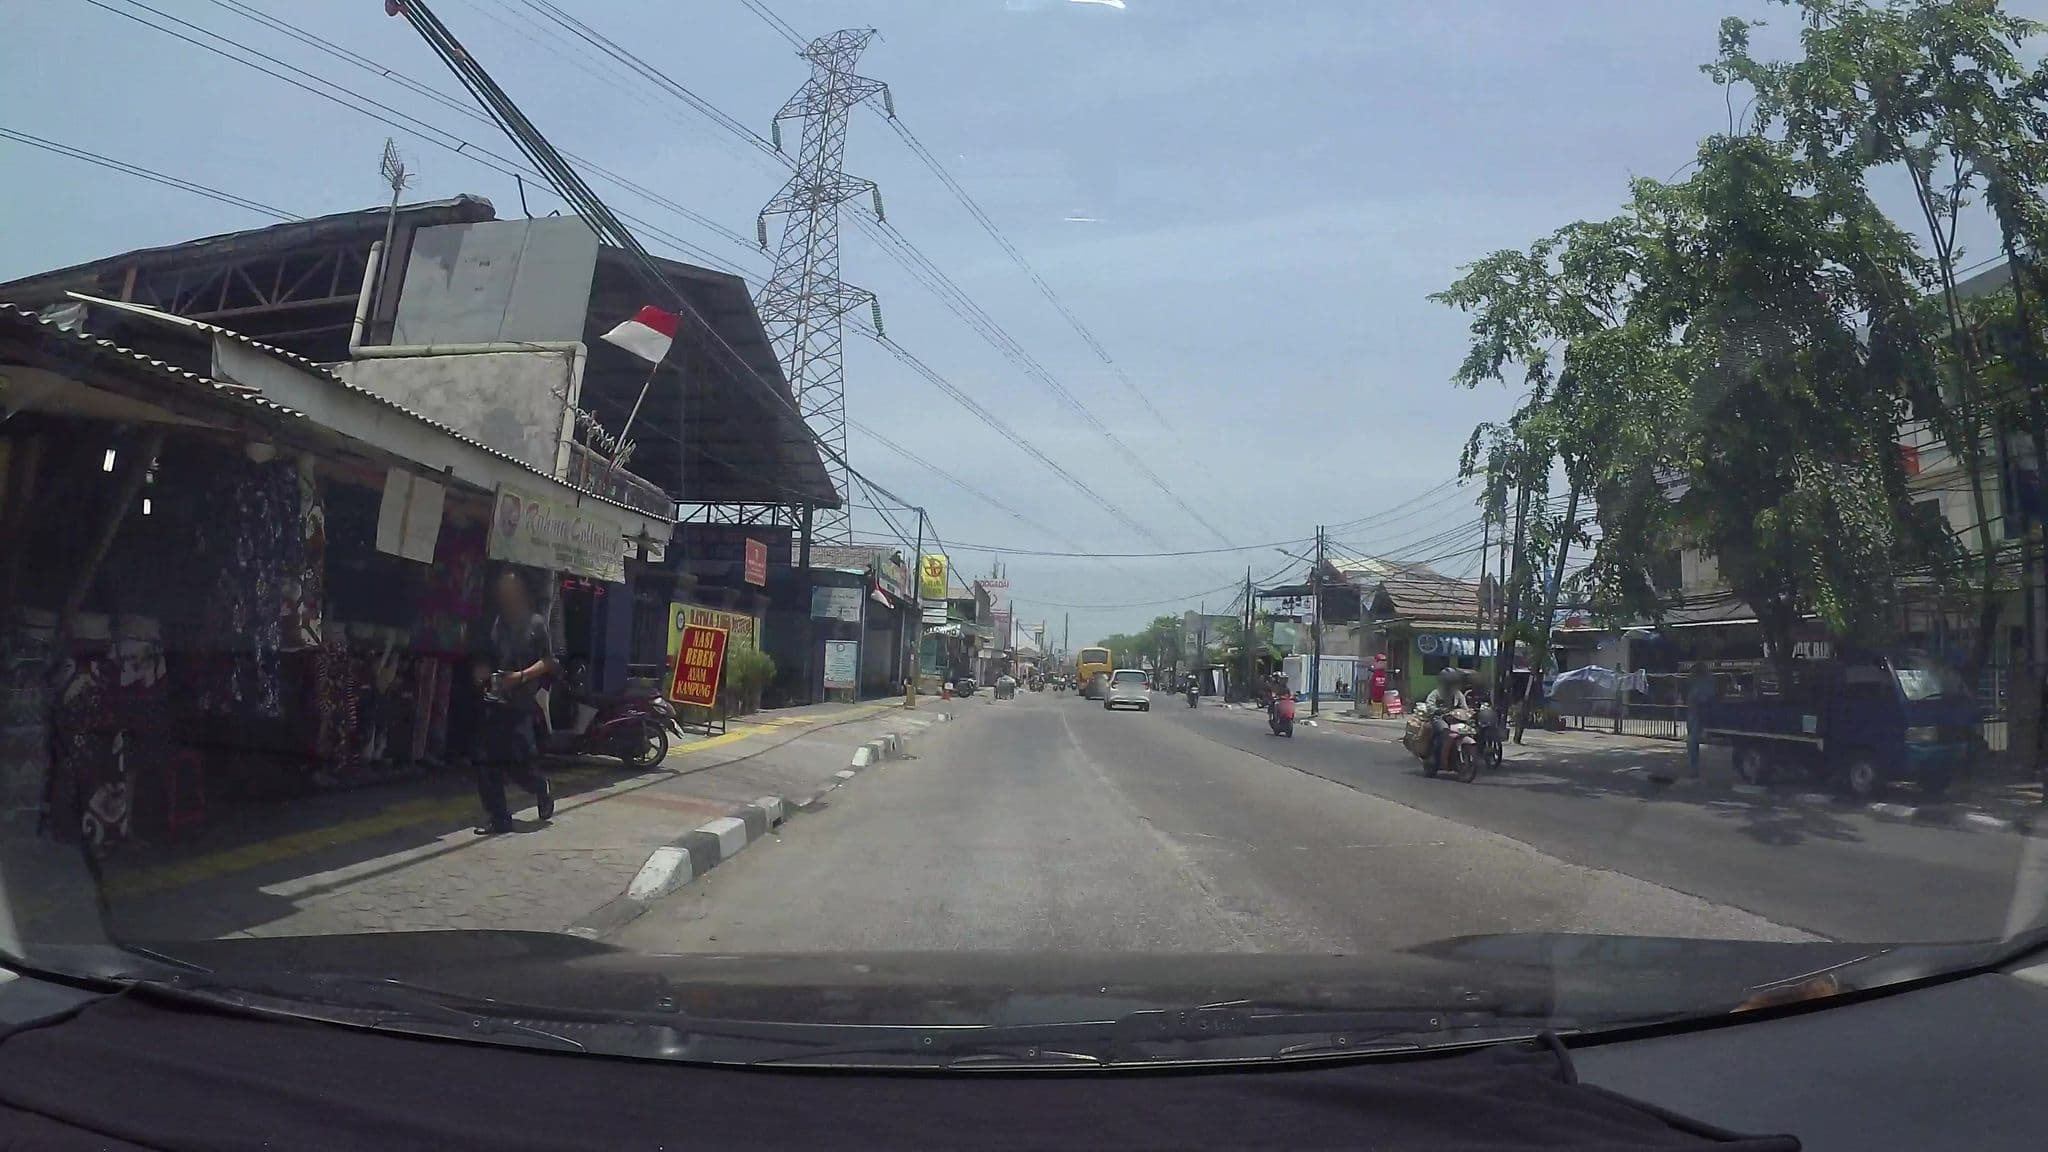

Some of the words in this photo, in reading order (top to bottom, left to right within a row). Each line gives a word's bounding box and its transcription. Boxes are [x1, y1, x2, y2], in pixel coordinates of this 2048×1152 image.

[693, 630, 714, 649] NASI
[685, 647, 716, 668] BEBEK
[687, 667, 707, 683] AYAM
[676, 681, 712, 698] KAMPUNG
